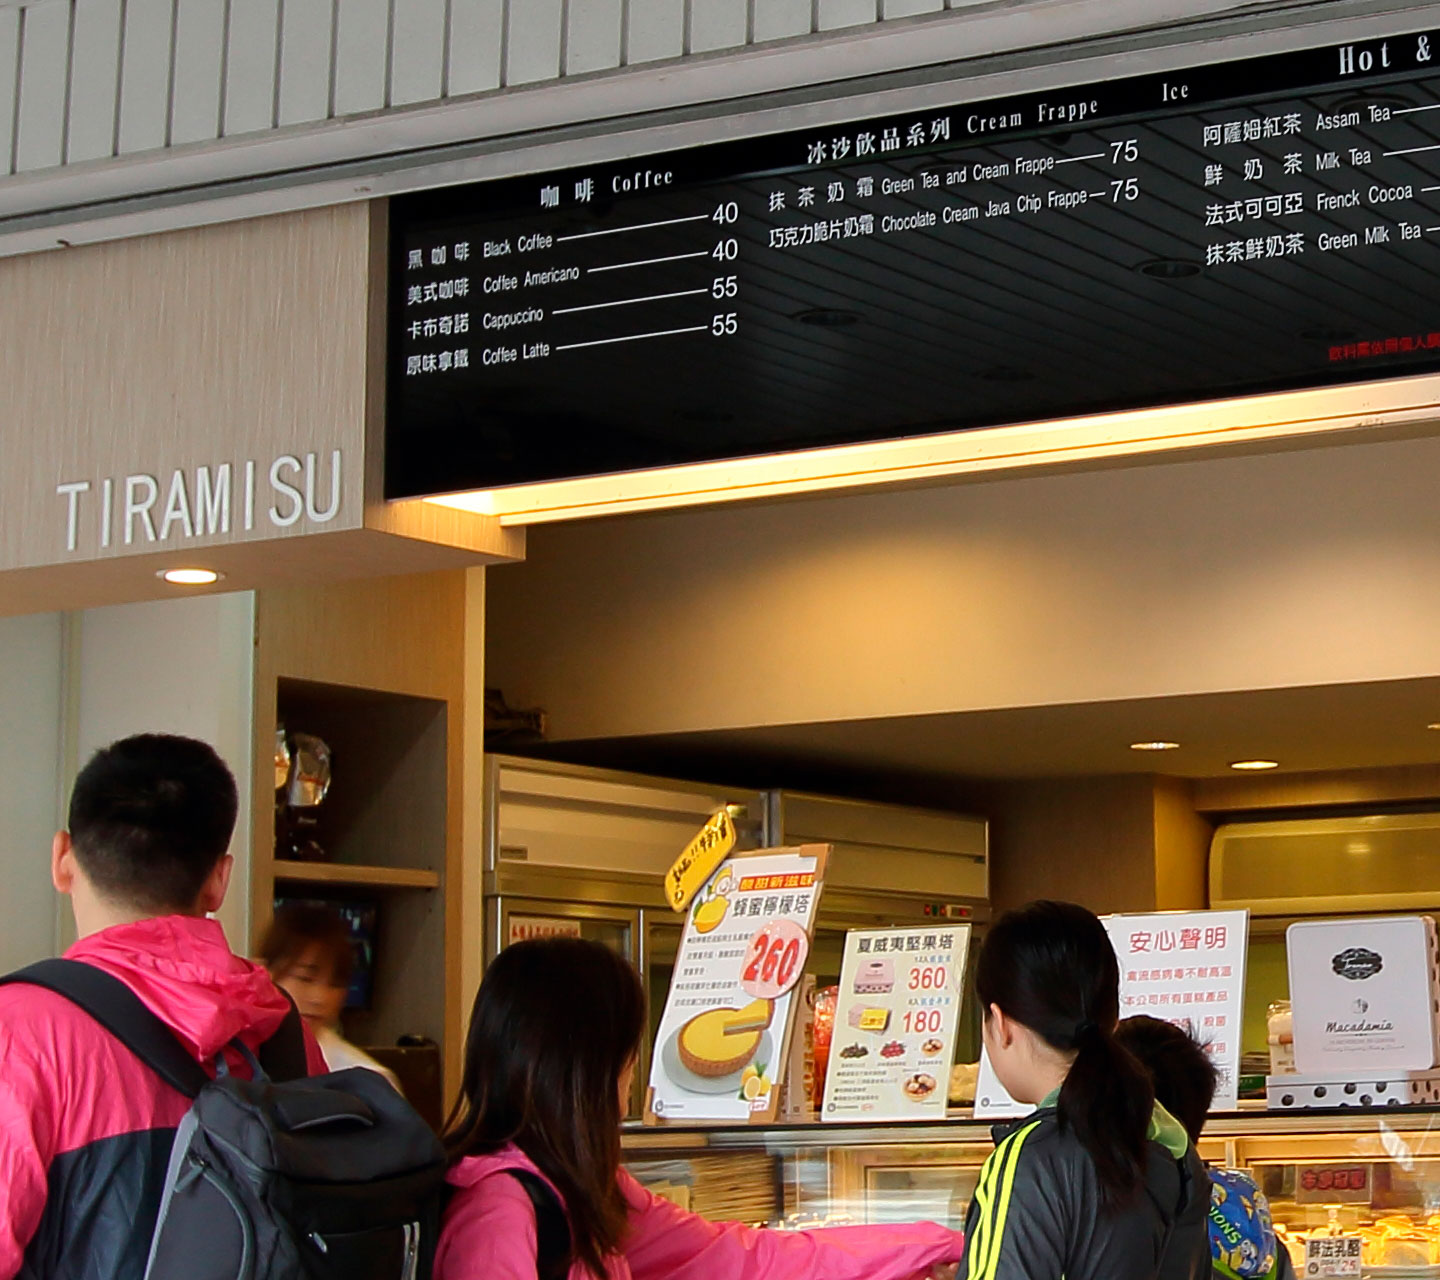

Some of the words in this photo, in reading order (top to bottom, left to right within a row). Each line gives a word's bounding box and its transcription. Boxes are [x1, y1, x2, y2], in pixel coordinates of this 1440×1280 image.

[1338, 45, 1393, 76] Hot
[1416, 34, 1432, 62] &
[1162, 81, 1189, 102] Ice
[806, 116, 951, 165] 冰沙飲品系列
[966, 113, 1023, 133] Cream
[1037, 100, 1098, 122] Frappe
[1202, 113, 1302, 147] 阿薩姆紅茶
[1315, 111, 1360, 131] Assam
[1367, 105, 1391, 123] Tea
[768, 176, 874, 212] 抹茶奶霜
[881, 177, 914, 195] Green
[920, 170, 940, 187] Tea
[946, 166, 967, 184] and
[972, 162, 1009, 181] Cream
[1015, 155, 1054, 176] Frappe
[1109, 139, 1139, 164] 75
[1203, 153, 1303, 186] 鮮奶茶
[1315, 151, 1341, 171] Milk
[1348, 148, 1372, 166] Tea
[540, 177, 595, 208] 咖啡
[611, 170, 673, 194] Coffee
[1204, 192, 1304, 226] 法式可可亞
[1316, 189, 1360, 210] Frenck
[1368, 185, 1413, 203] Cocoa
[768, 214, 874, 248] 巧克力脆片奶霜
[881, 211, 936, 233] Chocolate
[942, 205, 979, 223] Cream
[984, 200, 1010, 218] Java
[1016, 194, 1042, 214] Chip
[1047, 188, 1088, 210] Frappe
[1110, 177, 1139, 203] 75
[407, 241, 470, 269] 黑咖啡
[483, 239, 511, 258] Black
[517, 233, 553, 252] Coffee
[711, 202, 739, 224] 40
[1205, 232, 1305, 266] 抹茶鮮奶茶
[1318, 232, 1358, 251] Green
[1364, 226, 1390, 245] Milk
[1397, 222, 1422, 240] Tea
[407, 277, 470, 305] 美式咖啡
[483, 275, 518, 294] Coffee
[523, 265, 580, 287] Americano
[711, 238, 739, 261] 40
[407, 312, 470, 340] 卡布奇諾
[482, 307, 544, 331] Cappuccino
[711, 275, 738, 299] 55
[406, 348, 469, 375] 原味拿鐵
[482, 346, 517, 366] Coffee
[522, 341, 550, 360] Latte
[711, 313, 738, 336] 55
[56, 449, 341, 551] TIRAMISU
[732, 894, 810, 918] 蜂蜜檸檬塔
[743, 933, 800, 987] 260
[856, 933, 954, 954] 夏威夷堅果塔
[1129, 926, 1228, 954] 安心聲明
[908, 966, 946, 990] 360
[903, 1010, 941, 1033] 180
[1325, 1019, 1394, 1033] Macadamia
